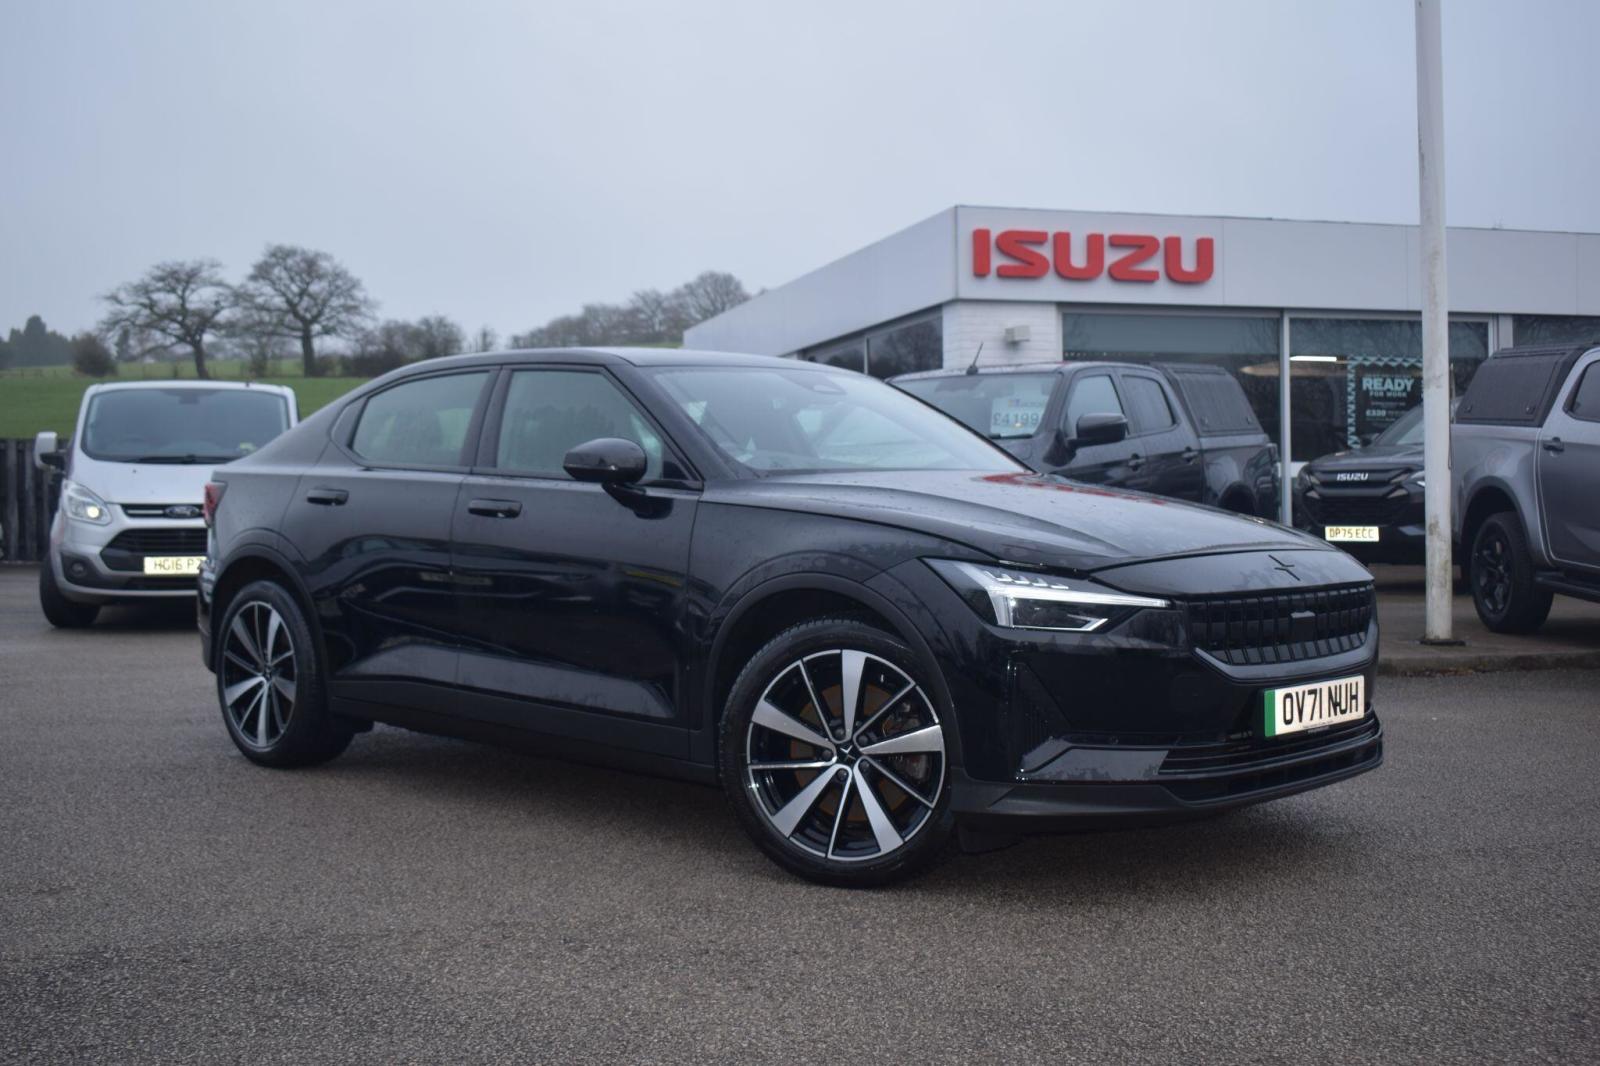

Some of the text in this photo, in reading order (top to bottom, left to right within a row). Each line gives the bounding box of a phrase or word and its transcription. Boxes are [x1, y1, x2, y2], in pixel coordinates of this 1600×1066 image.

[972, 228, 1214, 283] ISUZU
[1362, 377, 1414, 392] READY
[1336, 472, 1369, 481] ISUZU
[1329, 528, 1375, 539] DP75 ECC
[153, 558, 183, 571] HG16
[1283, 682, 1358, 725] OV71 NUH
